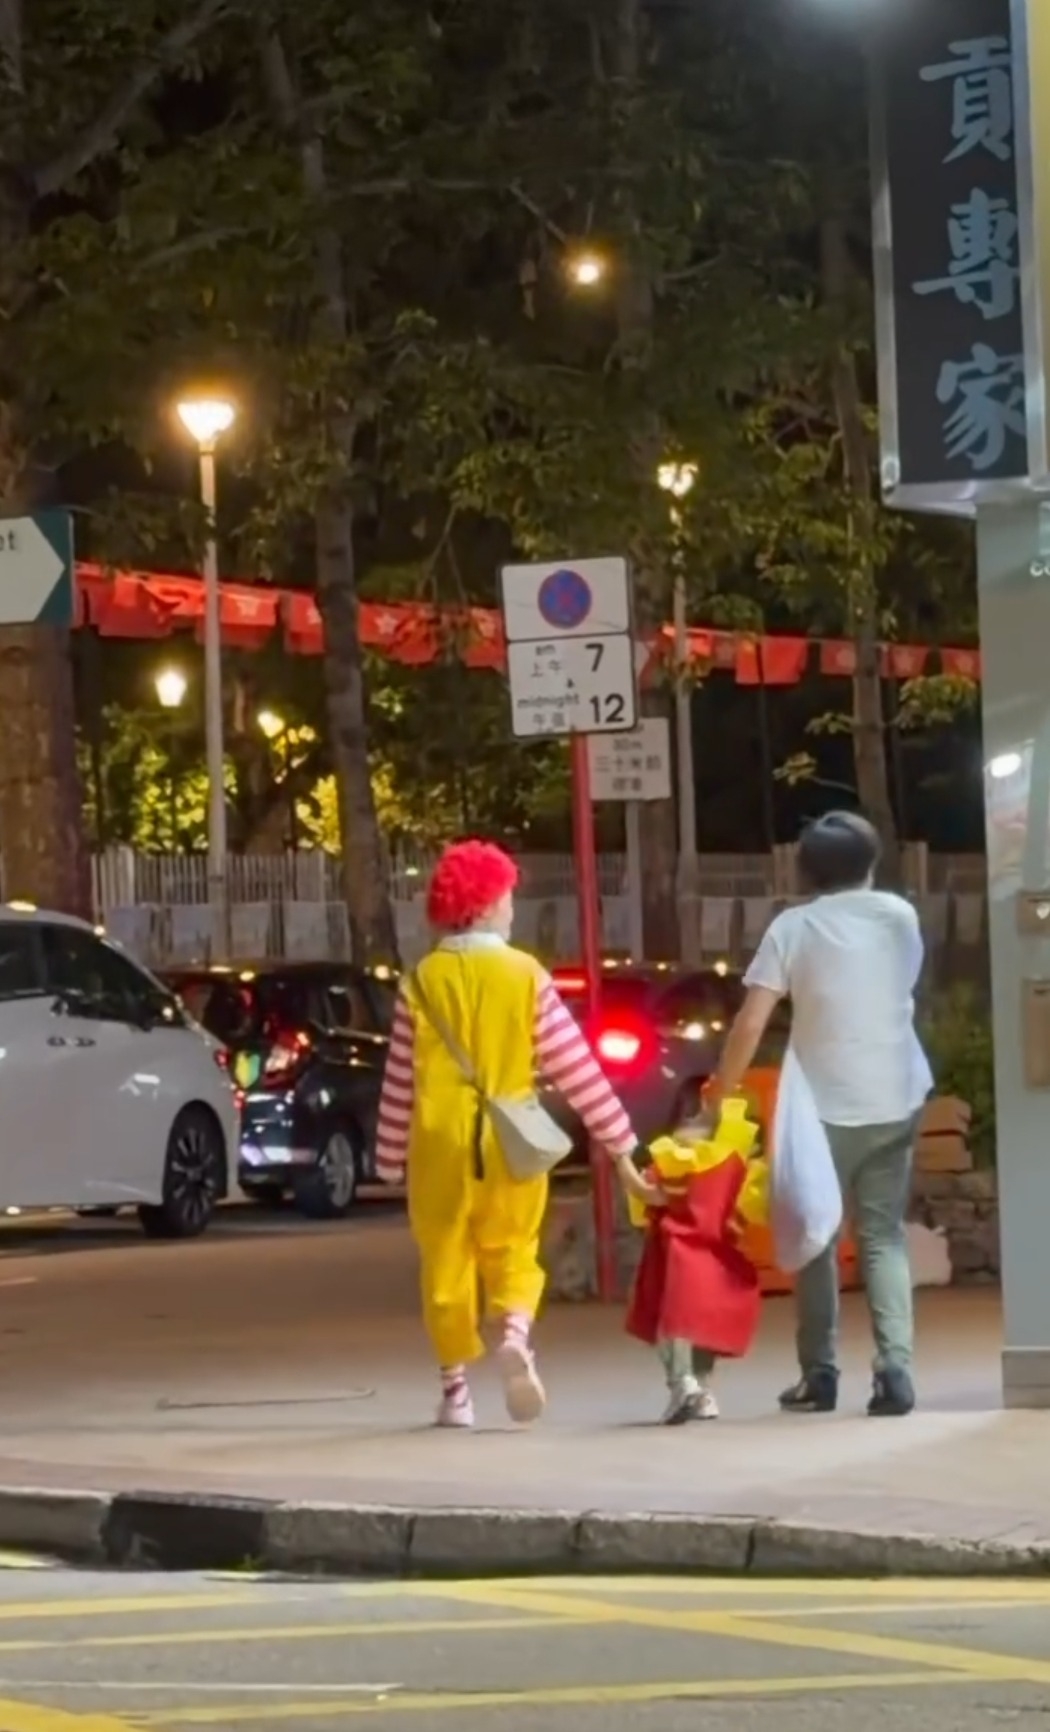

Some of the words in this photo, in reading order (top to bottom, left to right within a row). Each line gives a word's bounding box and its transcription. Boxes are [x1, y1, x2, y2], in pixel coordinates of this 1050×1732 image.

[585, 643, 604, 672] 7
[517, 693, 579, 708] midnight
[589, 693, 625, 724] 12
